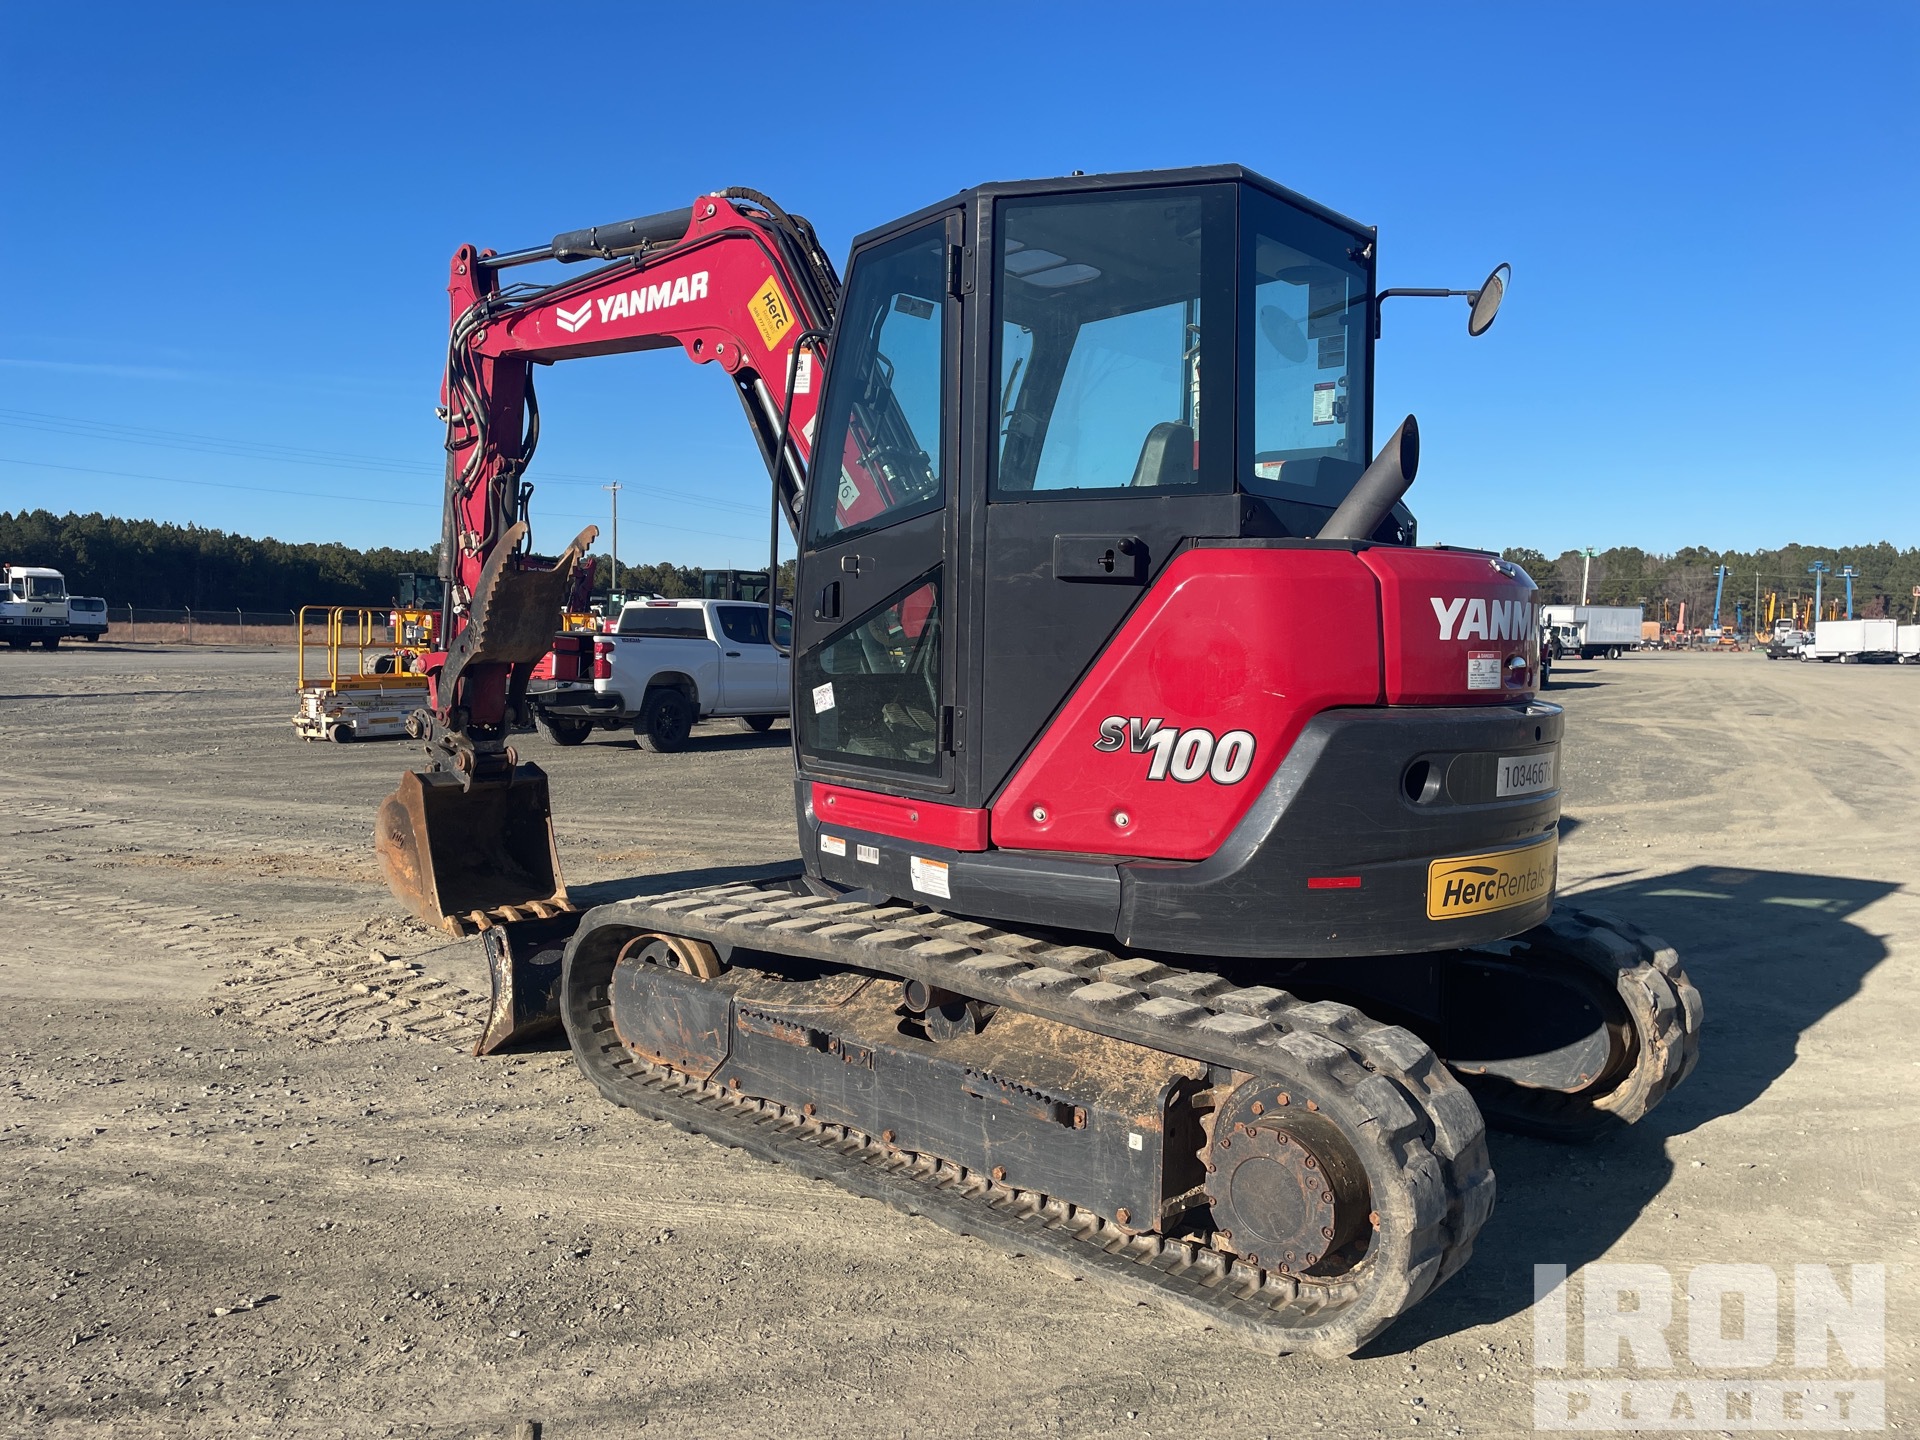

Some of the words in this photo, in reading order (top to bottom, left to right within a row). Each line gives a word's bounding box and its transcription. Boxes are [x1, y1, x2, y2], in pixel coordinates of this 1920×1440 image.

[596, 271, 709, 323] YANMAR
[762, 292, 784, 330] Herc
[1430, 597, 1540, 641] YANMA
